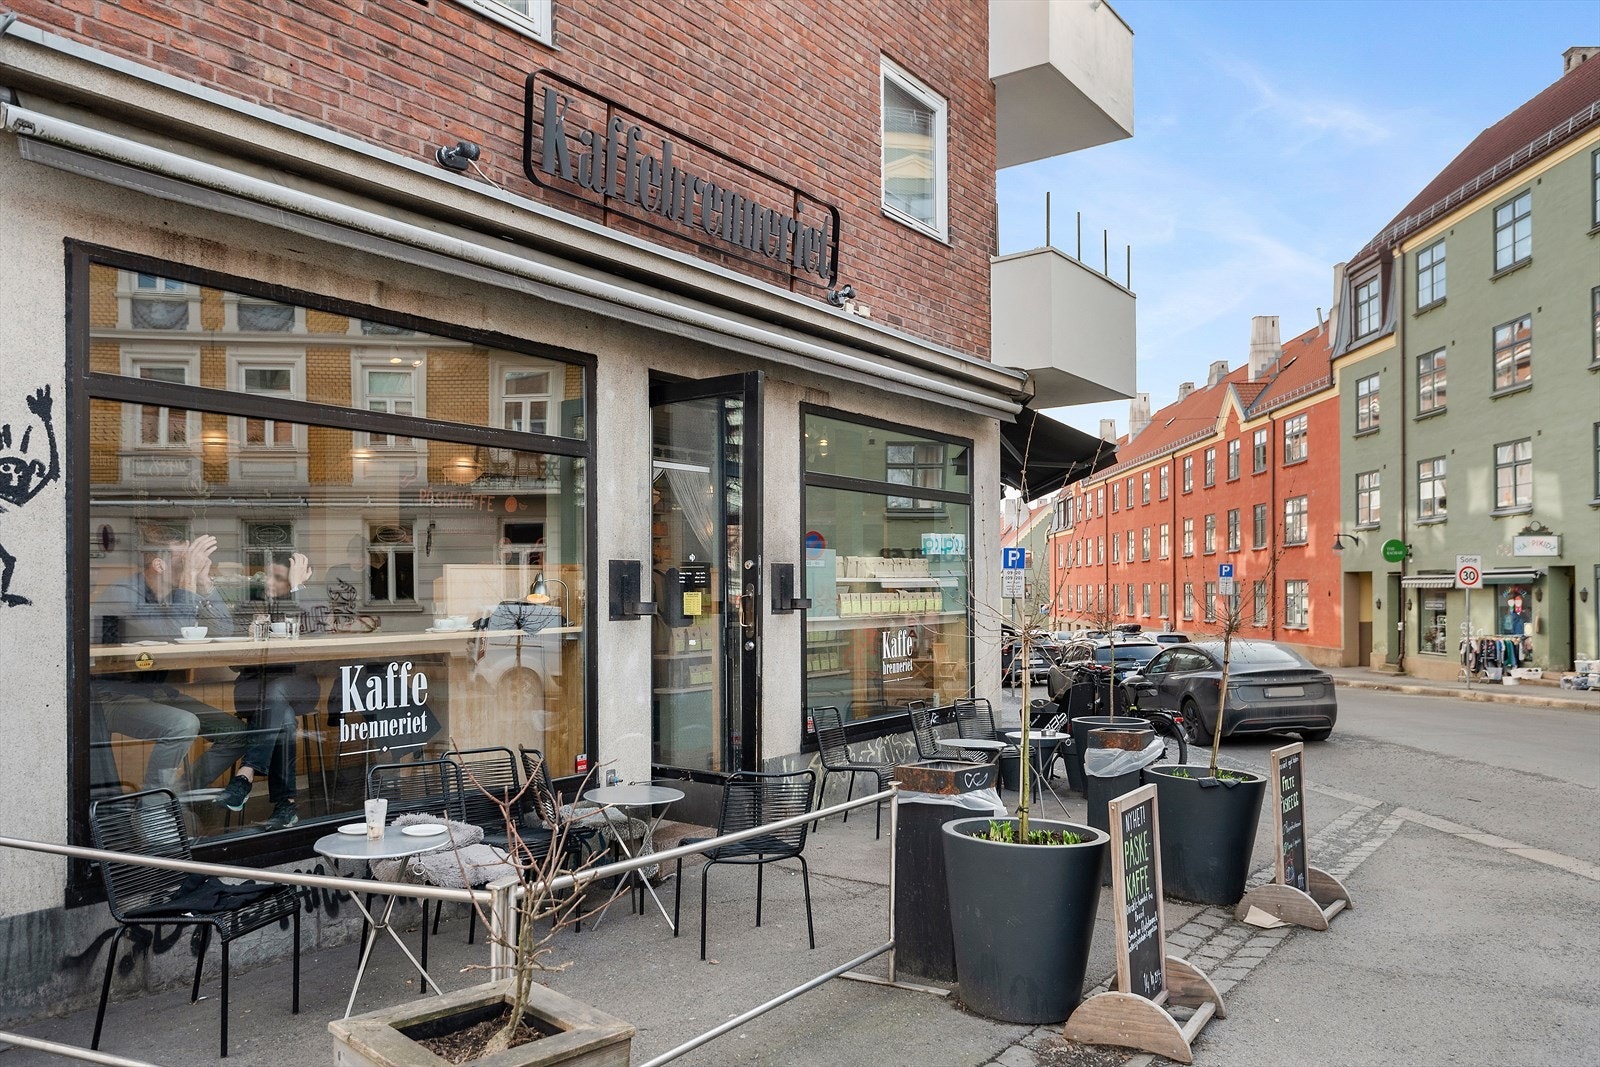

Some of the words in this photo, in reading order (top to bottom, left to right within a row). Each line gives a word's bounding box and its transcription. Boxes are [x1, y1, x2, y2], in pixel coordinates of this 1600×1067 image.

[541, 86, 833, 280] Kaffebrenneriet
[1008, 550, 1021, 567] P
[1222, 565, 1230, 576] P
[1462, 570, 1476, 581] 30
[882, 629, 913, 659] Kaffe
[882, 658, 913, 675] brenneriet
[339, 661, 428, 714] Kaffe
[339, 711, 428, 743] brenneriet
[1125, 805, 1146, 833] NYHET!
[1126, 865, 1150, 901] KAFFE
